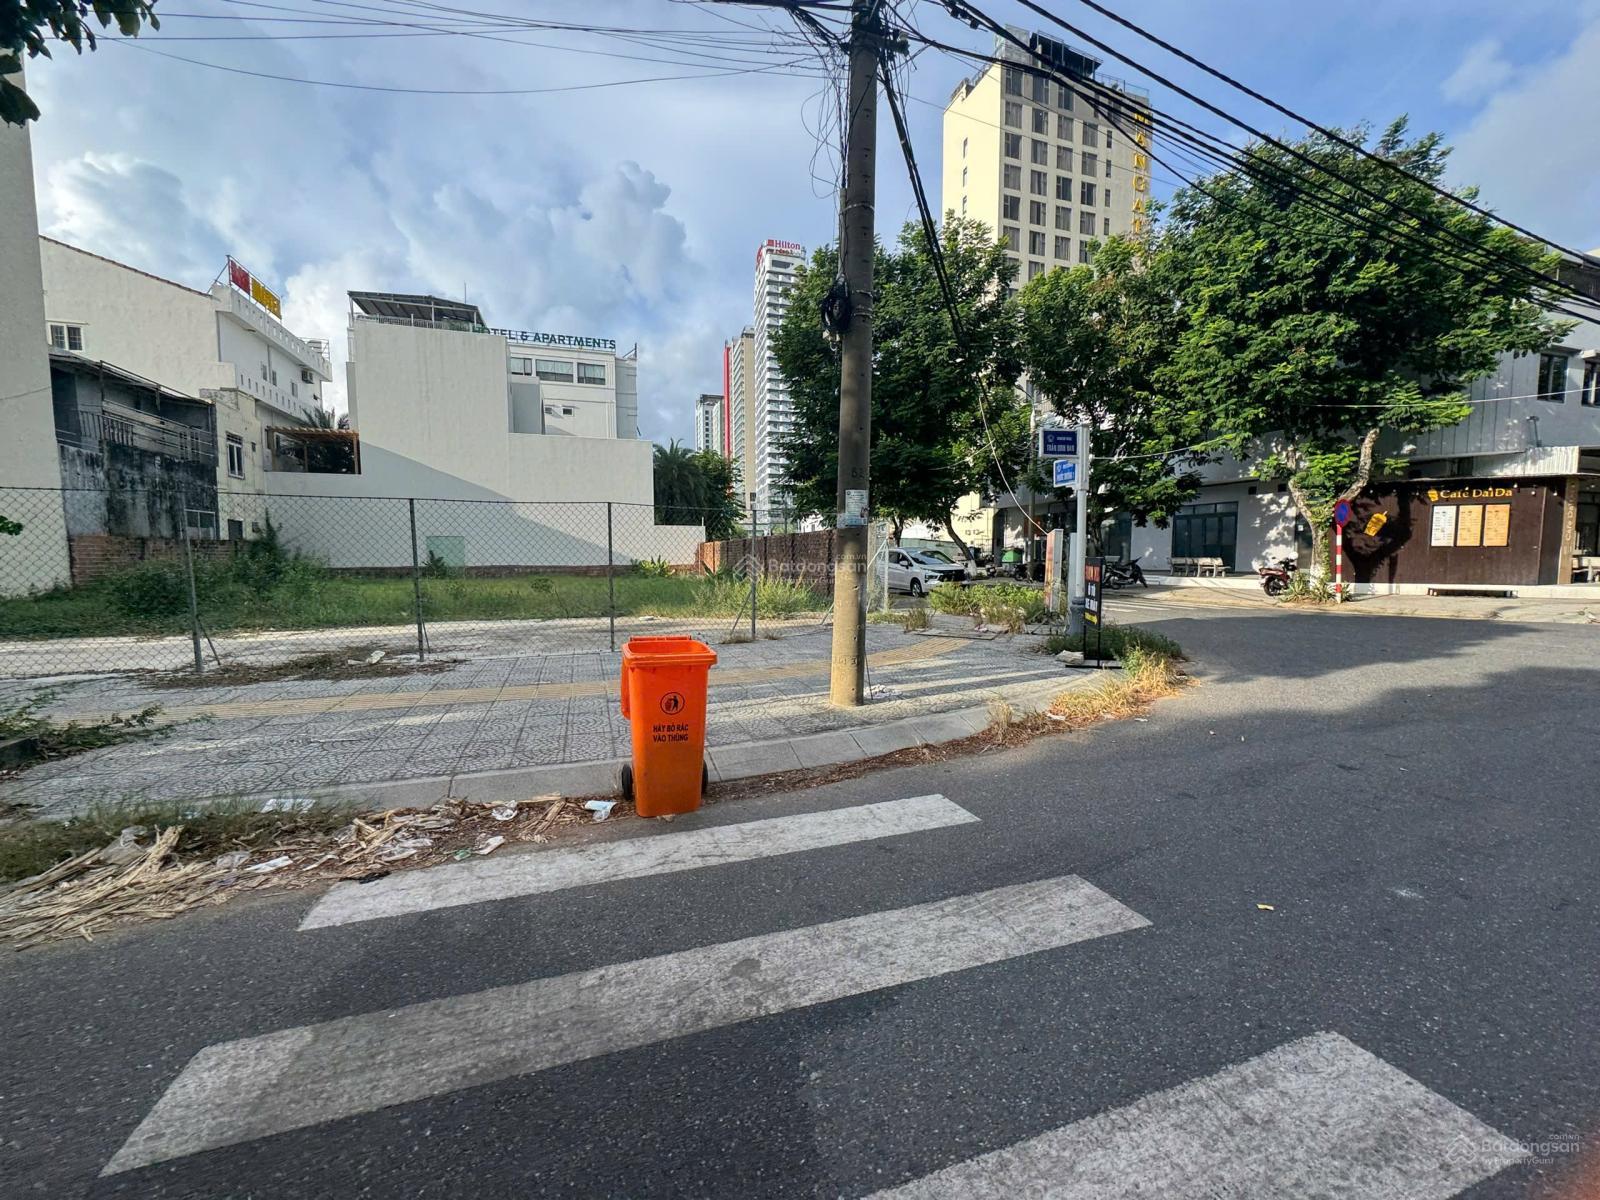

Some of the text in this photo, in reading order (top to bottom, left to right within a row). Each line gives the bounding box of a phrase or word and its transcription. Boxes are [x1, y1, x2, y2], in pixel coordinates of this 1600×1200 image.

[774, 240, 801, 250] Hilton
[520, 331, 529, 341] &
[533, 332, 616, 349] APARTMENTS
[676, 722, 688, 731] RÁC
[653, 733, 667, 742] VÀO
